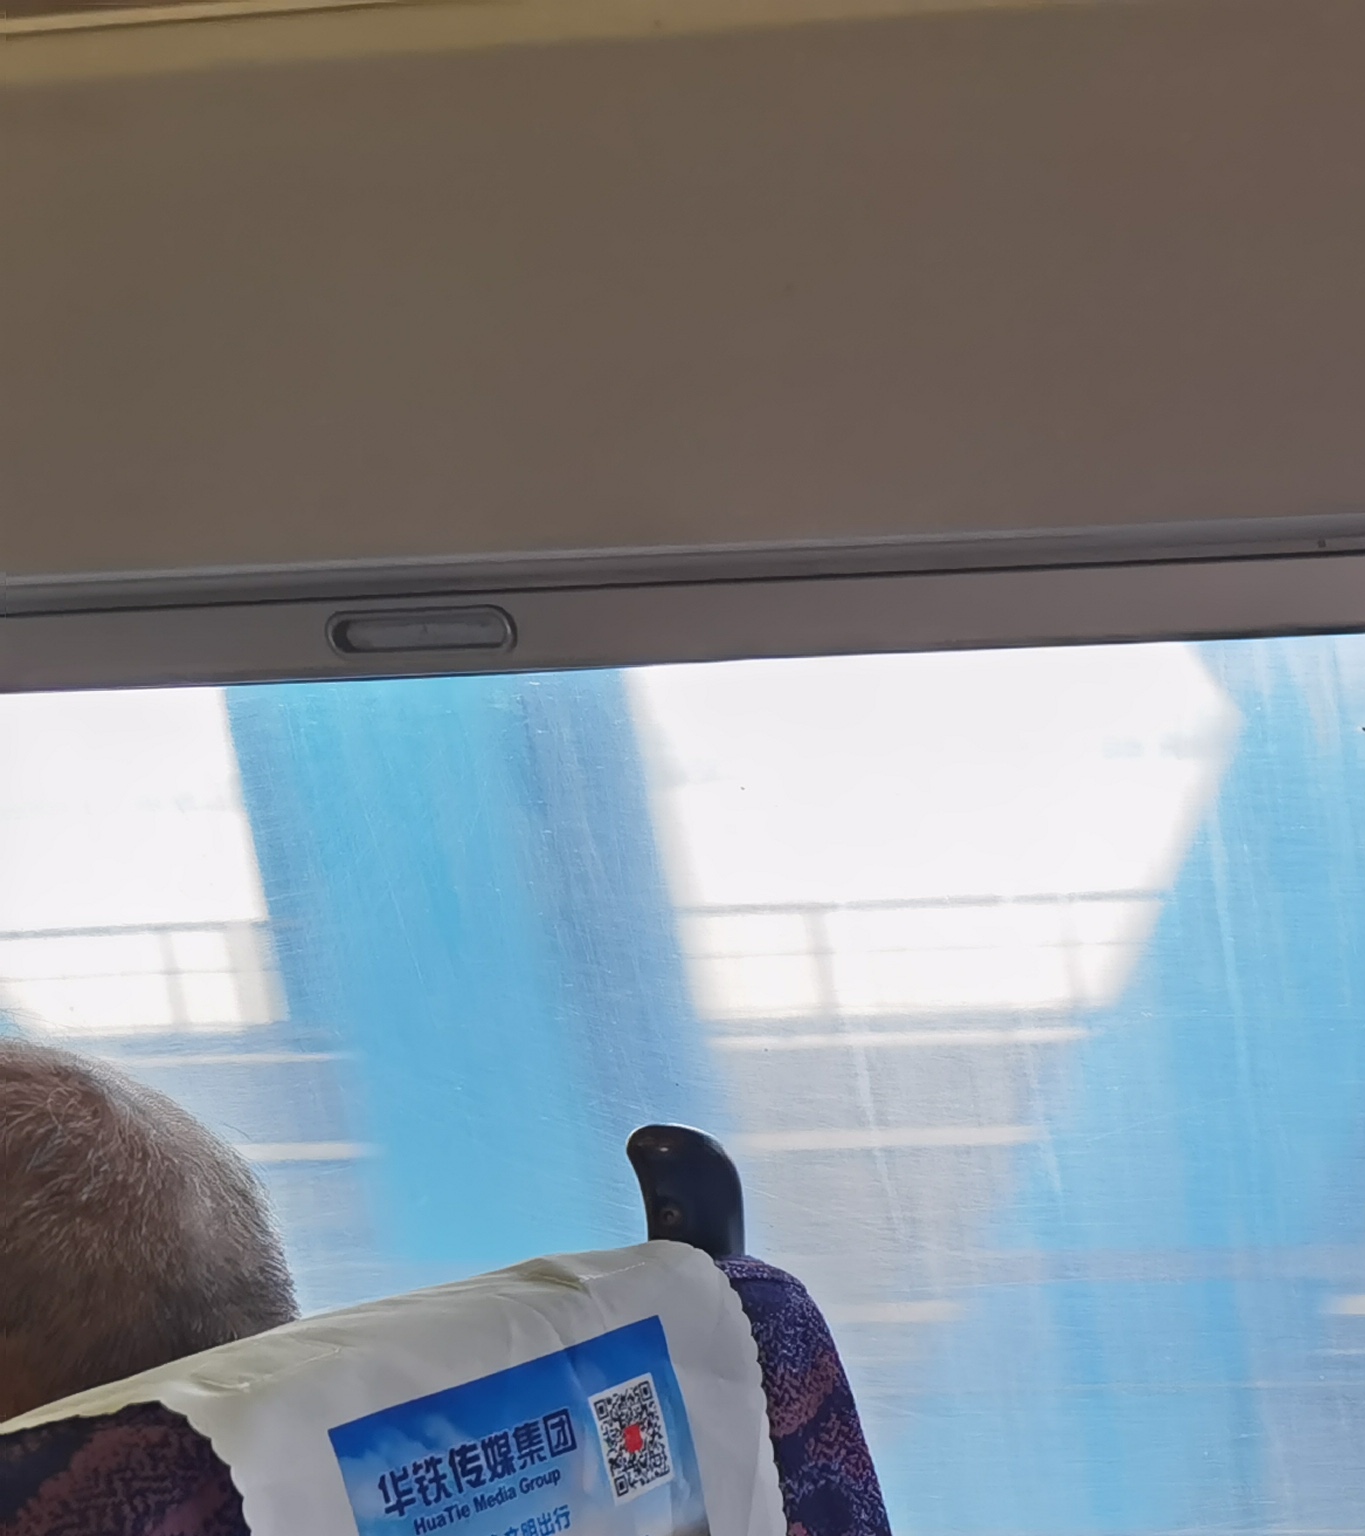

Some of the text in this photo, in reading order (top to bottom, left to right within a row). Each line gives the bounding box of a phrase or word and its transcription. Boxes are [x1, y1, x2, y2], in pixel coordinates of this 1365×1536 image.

[377, 1408, 577, 1516] 华铁传媒集团
[414, 1468, 561, 1535] HuaTie Media Group
